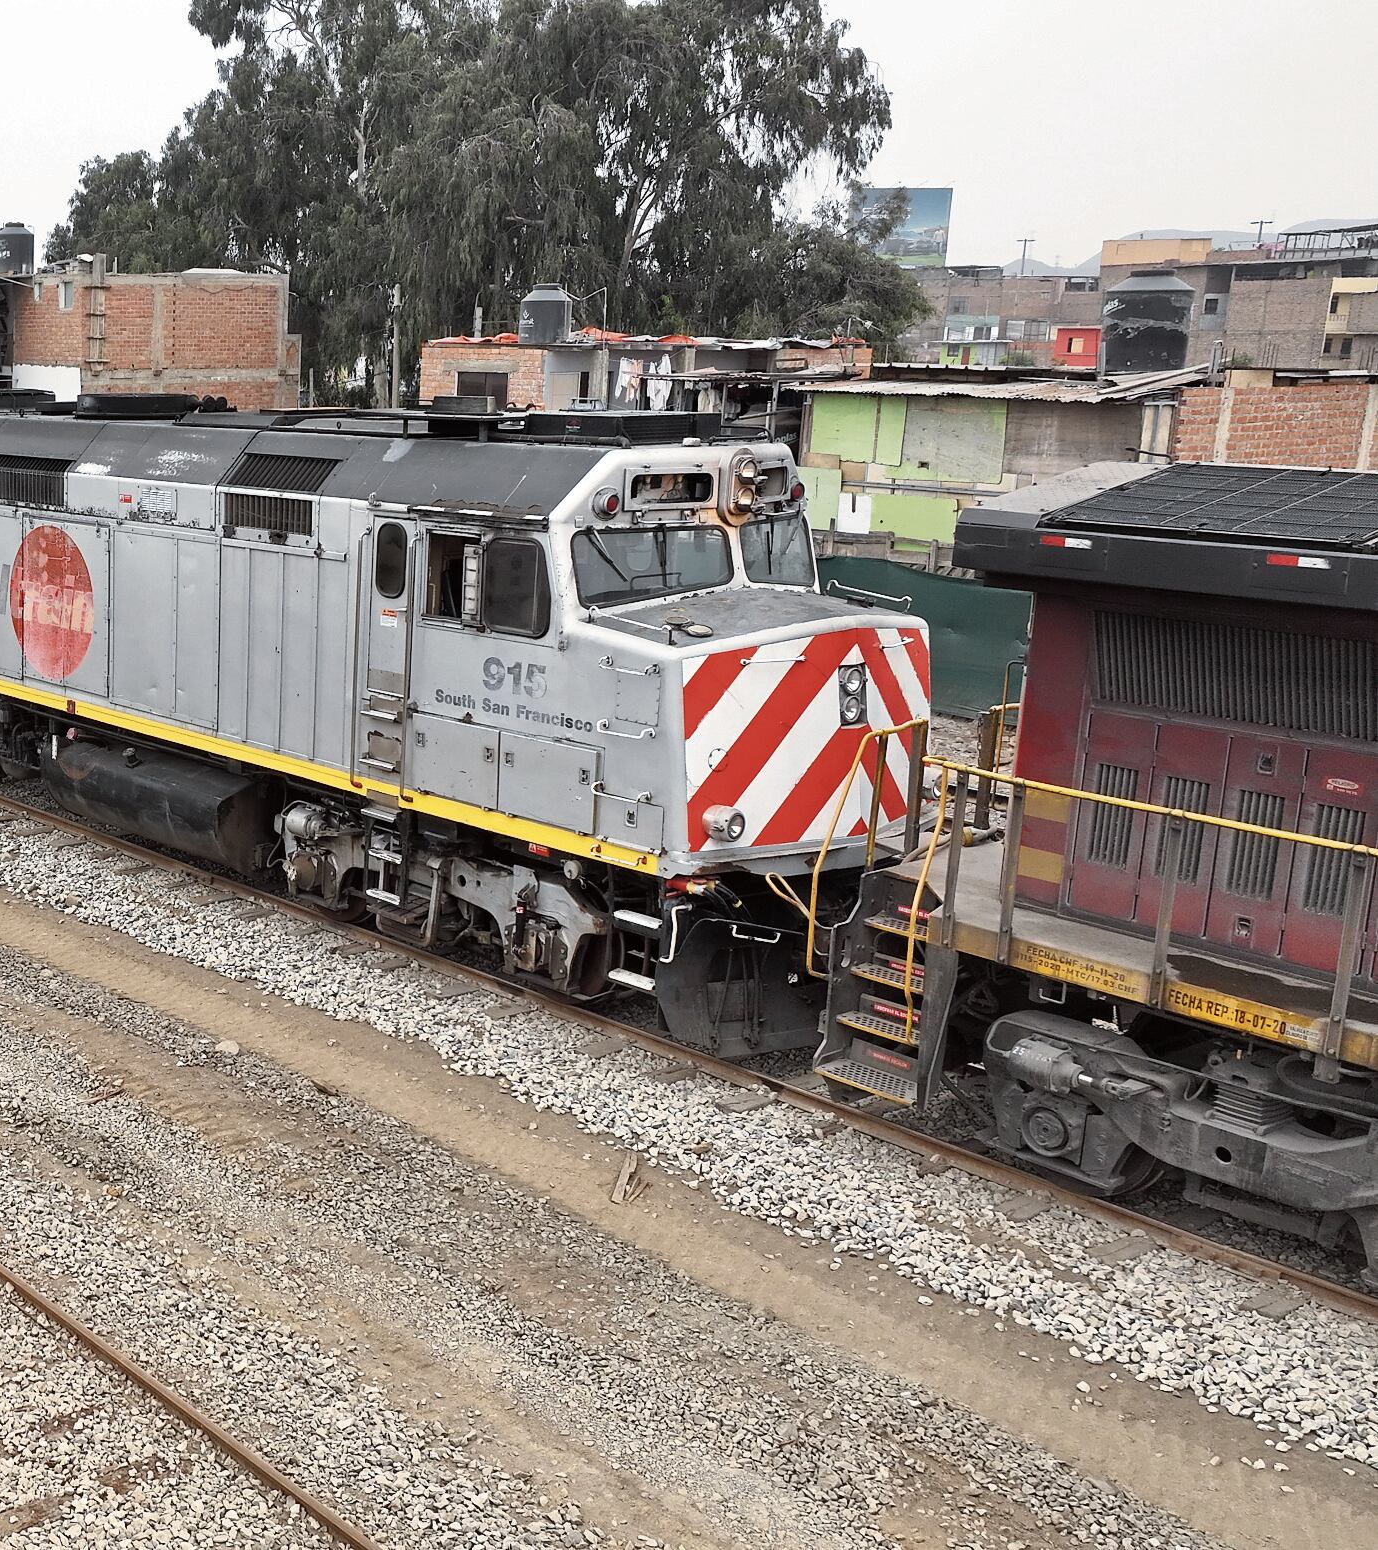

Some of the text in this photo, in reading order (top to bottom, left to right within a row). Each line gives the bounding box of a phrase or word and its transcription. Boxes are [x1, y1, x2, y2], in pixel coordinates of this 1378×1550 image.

[482, 656, 548, 699] 915
[435, 688, 594, 733] South San Francisco
[1026, 945, 1057, 962] FECHA
[1168, 989, 1203, 1013] FECHA
